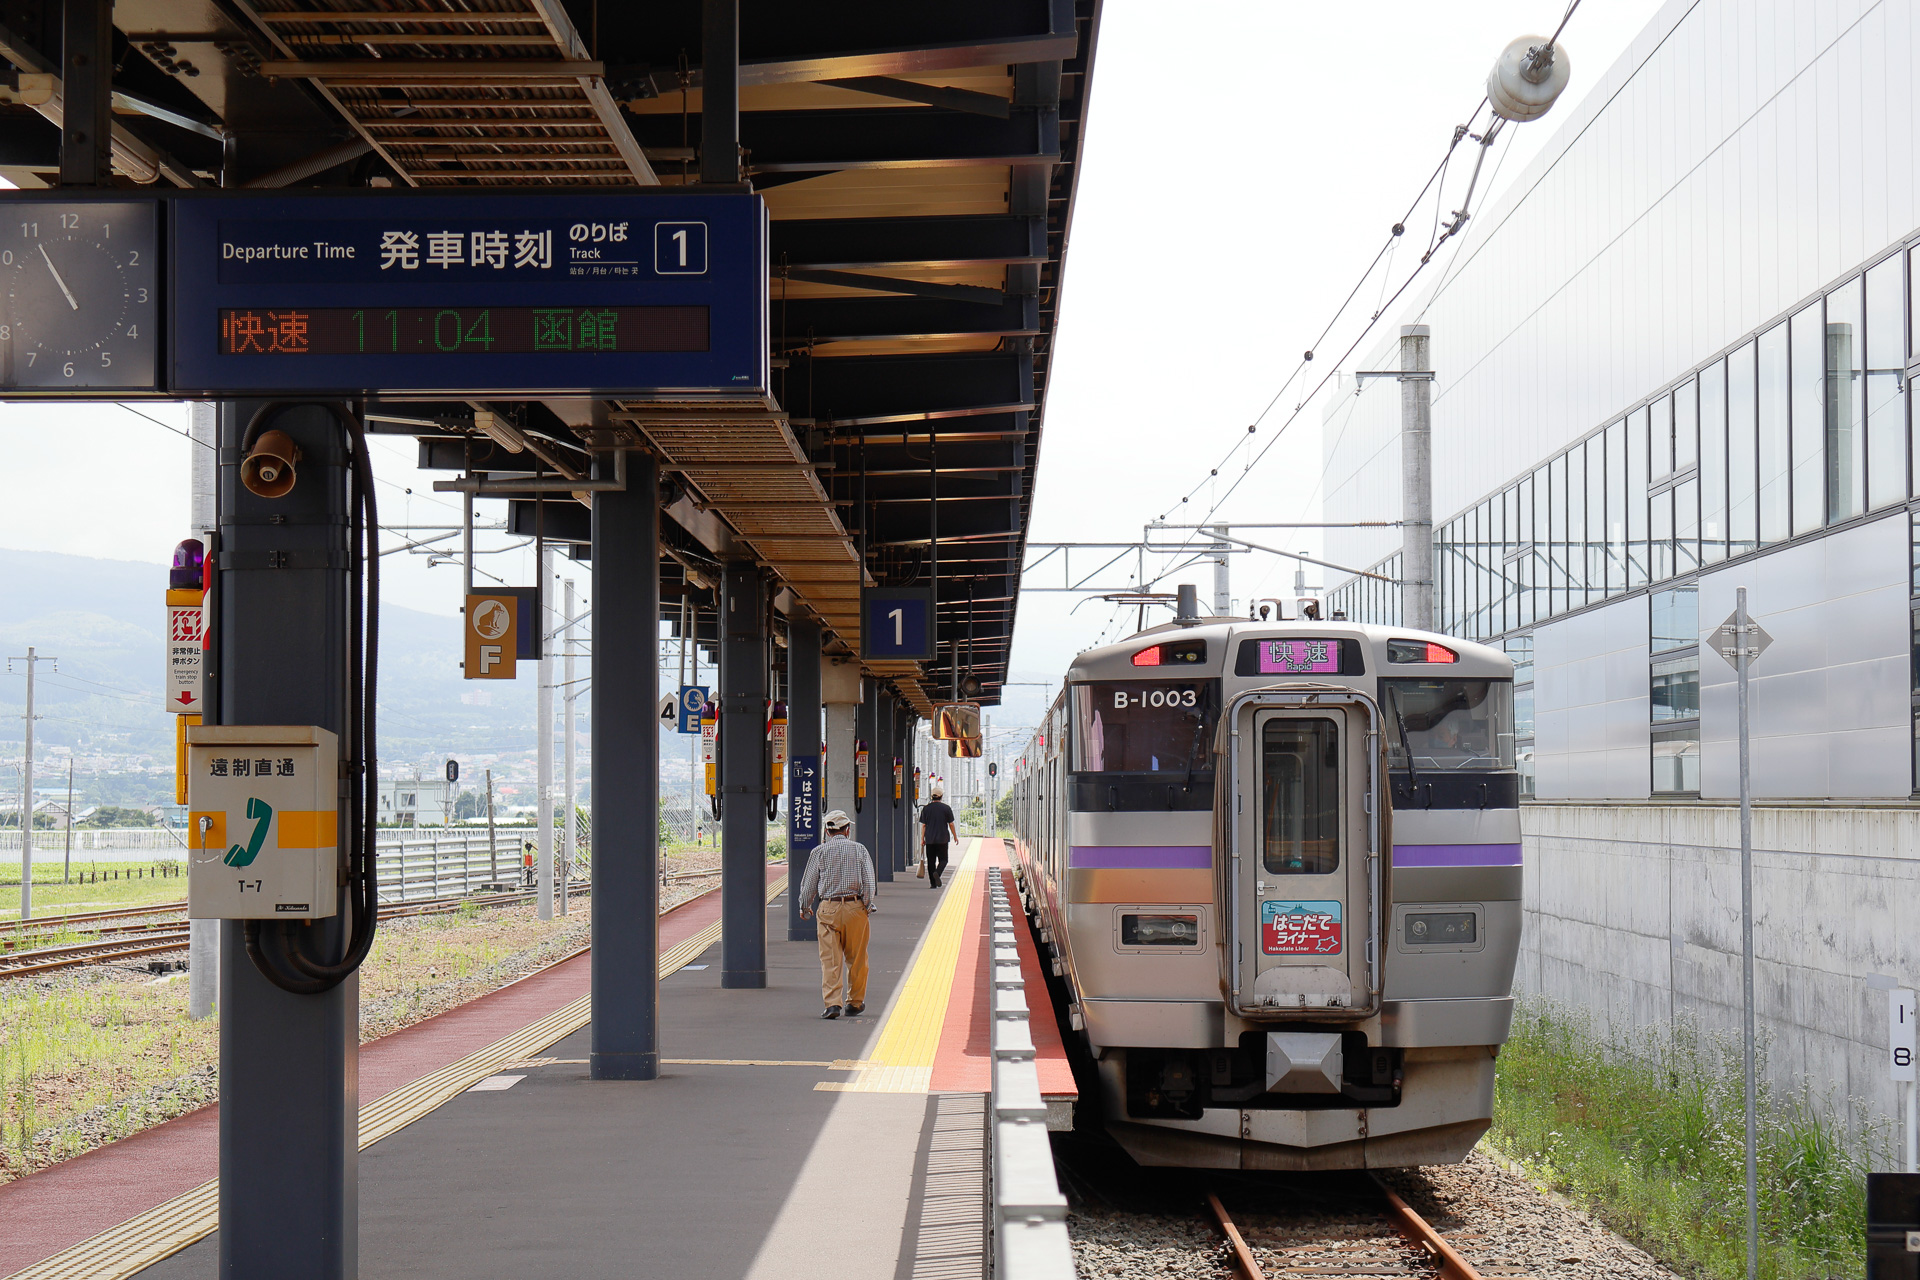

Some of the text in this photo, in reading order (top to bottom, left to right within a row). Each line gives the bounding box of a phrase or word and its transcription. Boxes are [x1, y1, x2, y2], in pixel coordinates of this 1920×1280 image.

[60, 213, 79, 229] 12
[21, 222, 38, 238] 11
[103, 224, 110, 239] 1
[569, 221, 629, 242] のりば
[223, 242, 355, 263] Departure Time
[379, 229, 553, 270] 発車時刻
[569, 247, 601, 259] Track
[671, 229, 688, 267] 1
[129, 250, 139, 266] 2
[137, 288, 148, 303] 3
[0, 325, 11, 340] 8
[127, 324, 139, 340] 4
[223, 308, 618, 353] 快速 11:04 函館
[26, 352, 37, 367] 7
[101, 352, 111, 367] 5
[63, 362, 74, 378] 6
[888, 608, 903, 646] 1
[172, 647, 201, 655] 非常停止
[1269, 641, 1329, 663] 快速
[480, 645, 502, 674] F
[1287, 662, 1312, 673] Rapid
[1114, 690, 1197, 709] B-1003
[661, 702, 676, 720] 4
[687, 714, 699, 732] E
[210, 758, 295, 777] 遠制直通
[794, 796, 802, 829] ライナー
[802, 780, 812, 829] はこだて
[238, 880, 262, 893] T-7
[1272, 914, 1332, 931] はこだて
[1277, 932, 1320, 945] ライナー
